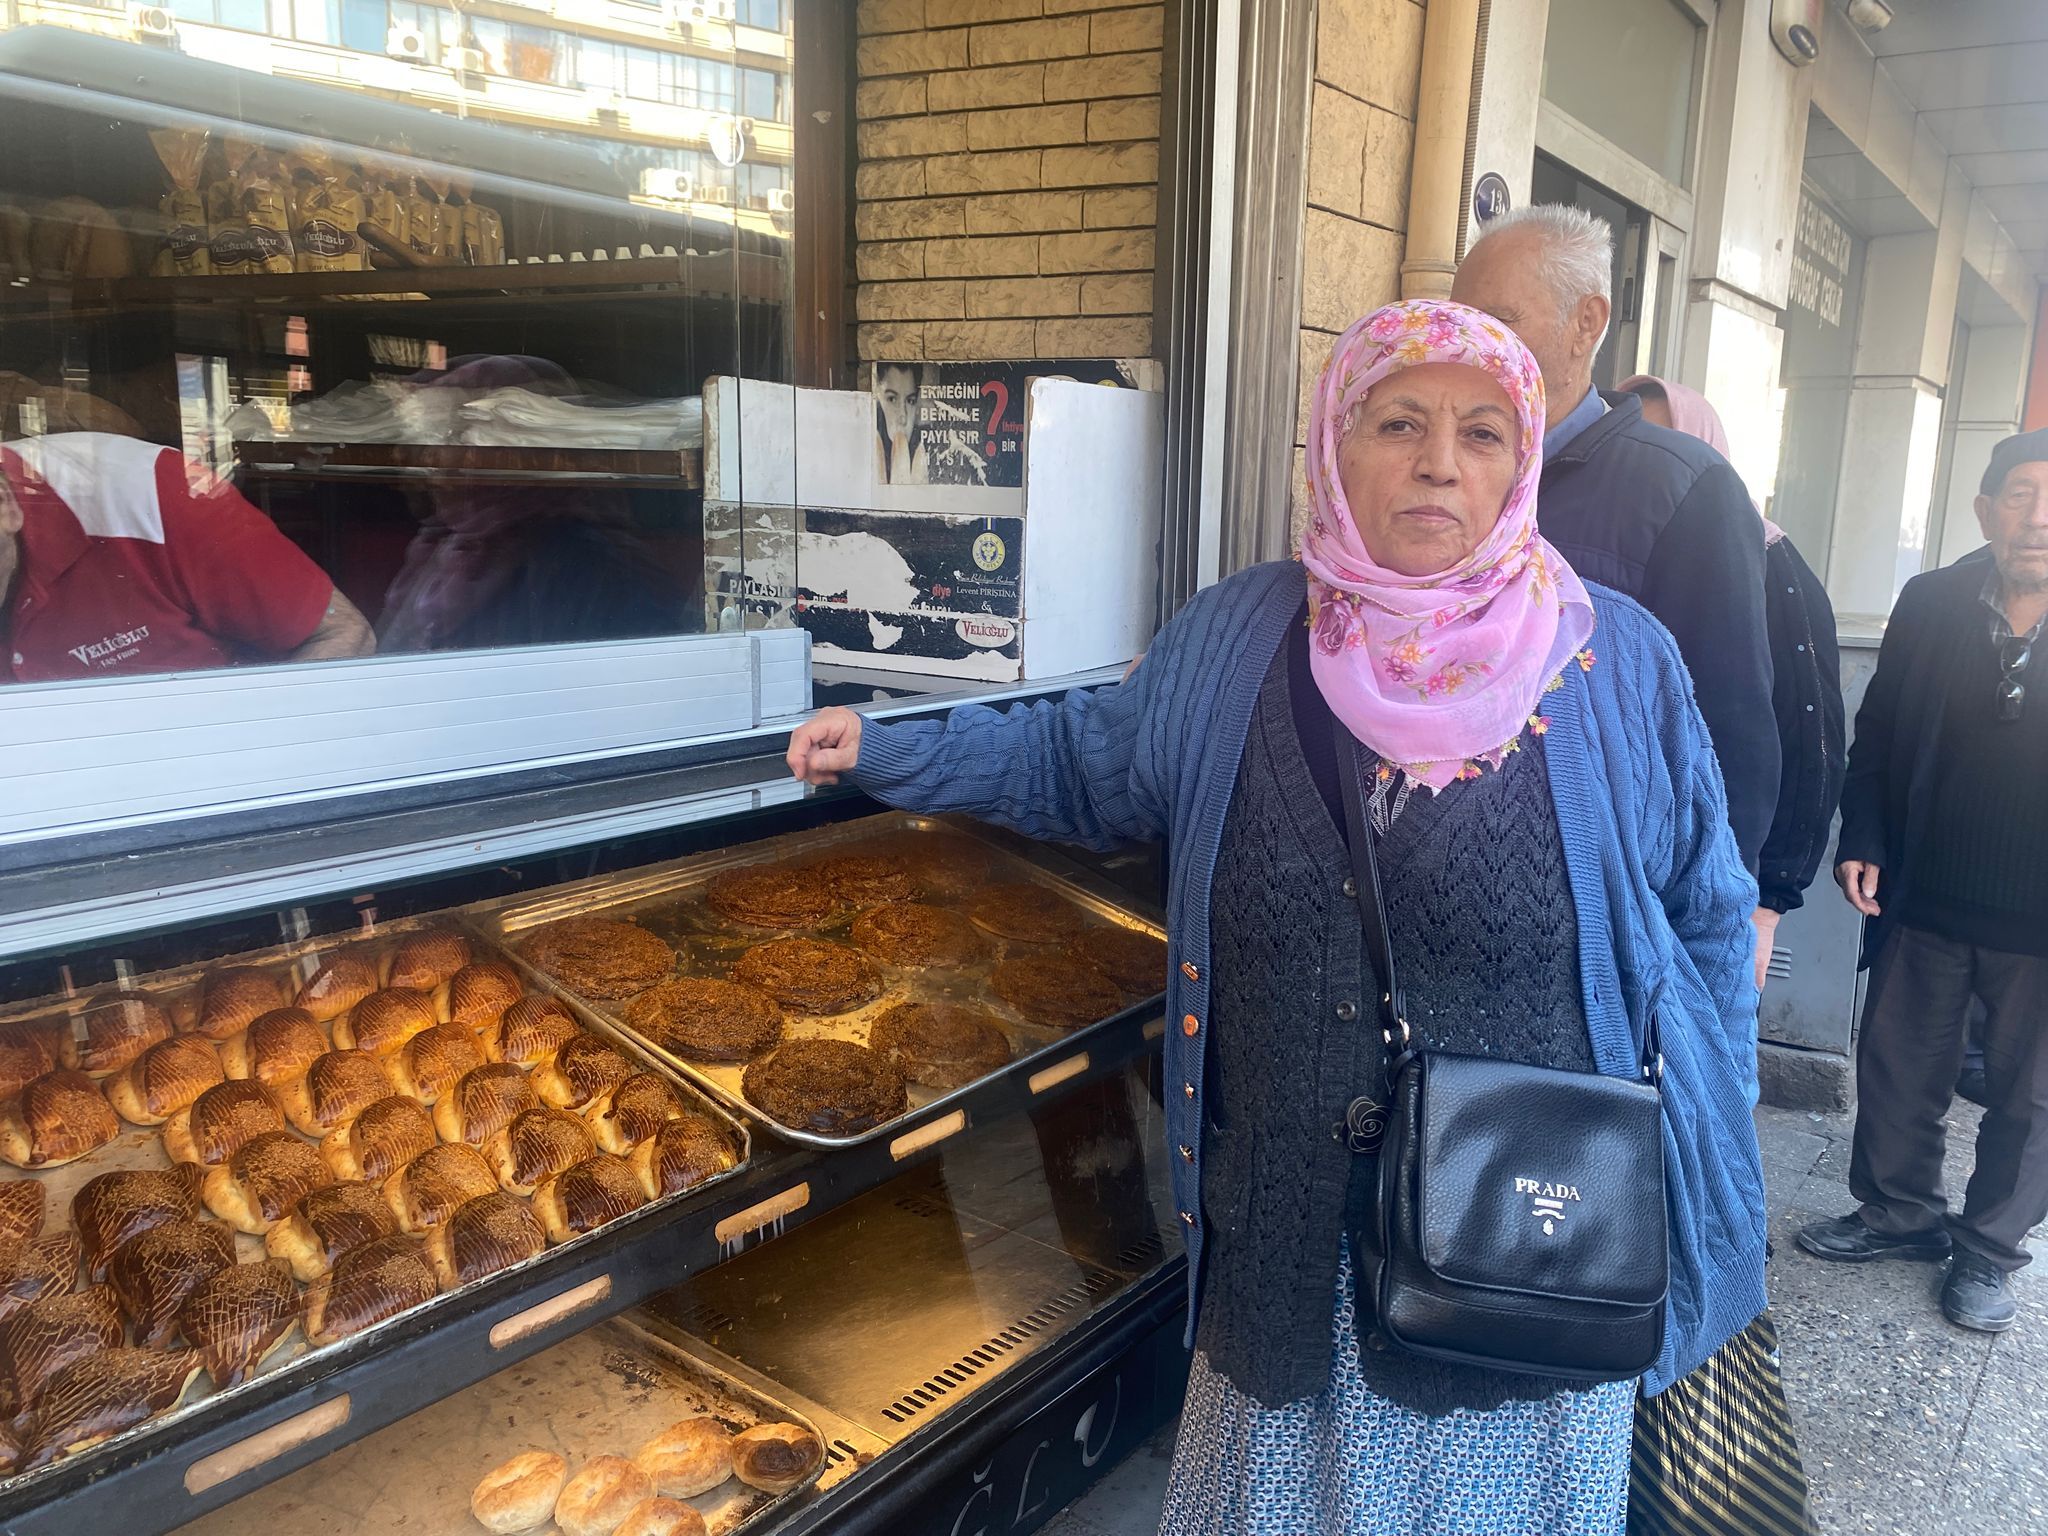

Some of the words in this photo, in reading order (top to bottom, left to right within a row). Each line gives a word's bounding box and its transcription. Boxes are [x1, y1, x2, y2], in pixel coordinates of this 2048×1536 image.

[919, 382, 980, 399] EKMEĞİNİ
[1001, 438, 1017, 453] BİR
[956, 586, 979, 596] Levent
[980, 587, 1017, 599] PİRİŞTİNA
[961, 620, 1009, 639] VELİOĞLU
[68, 625, 150, 668] VELİOĞLU
[1514, 1177, 1581, 1202] PRADA
